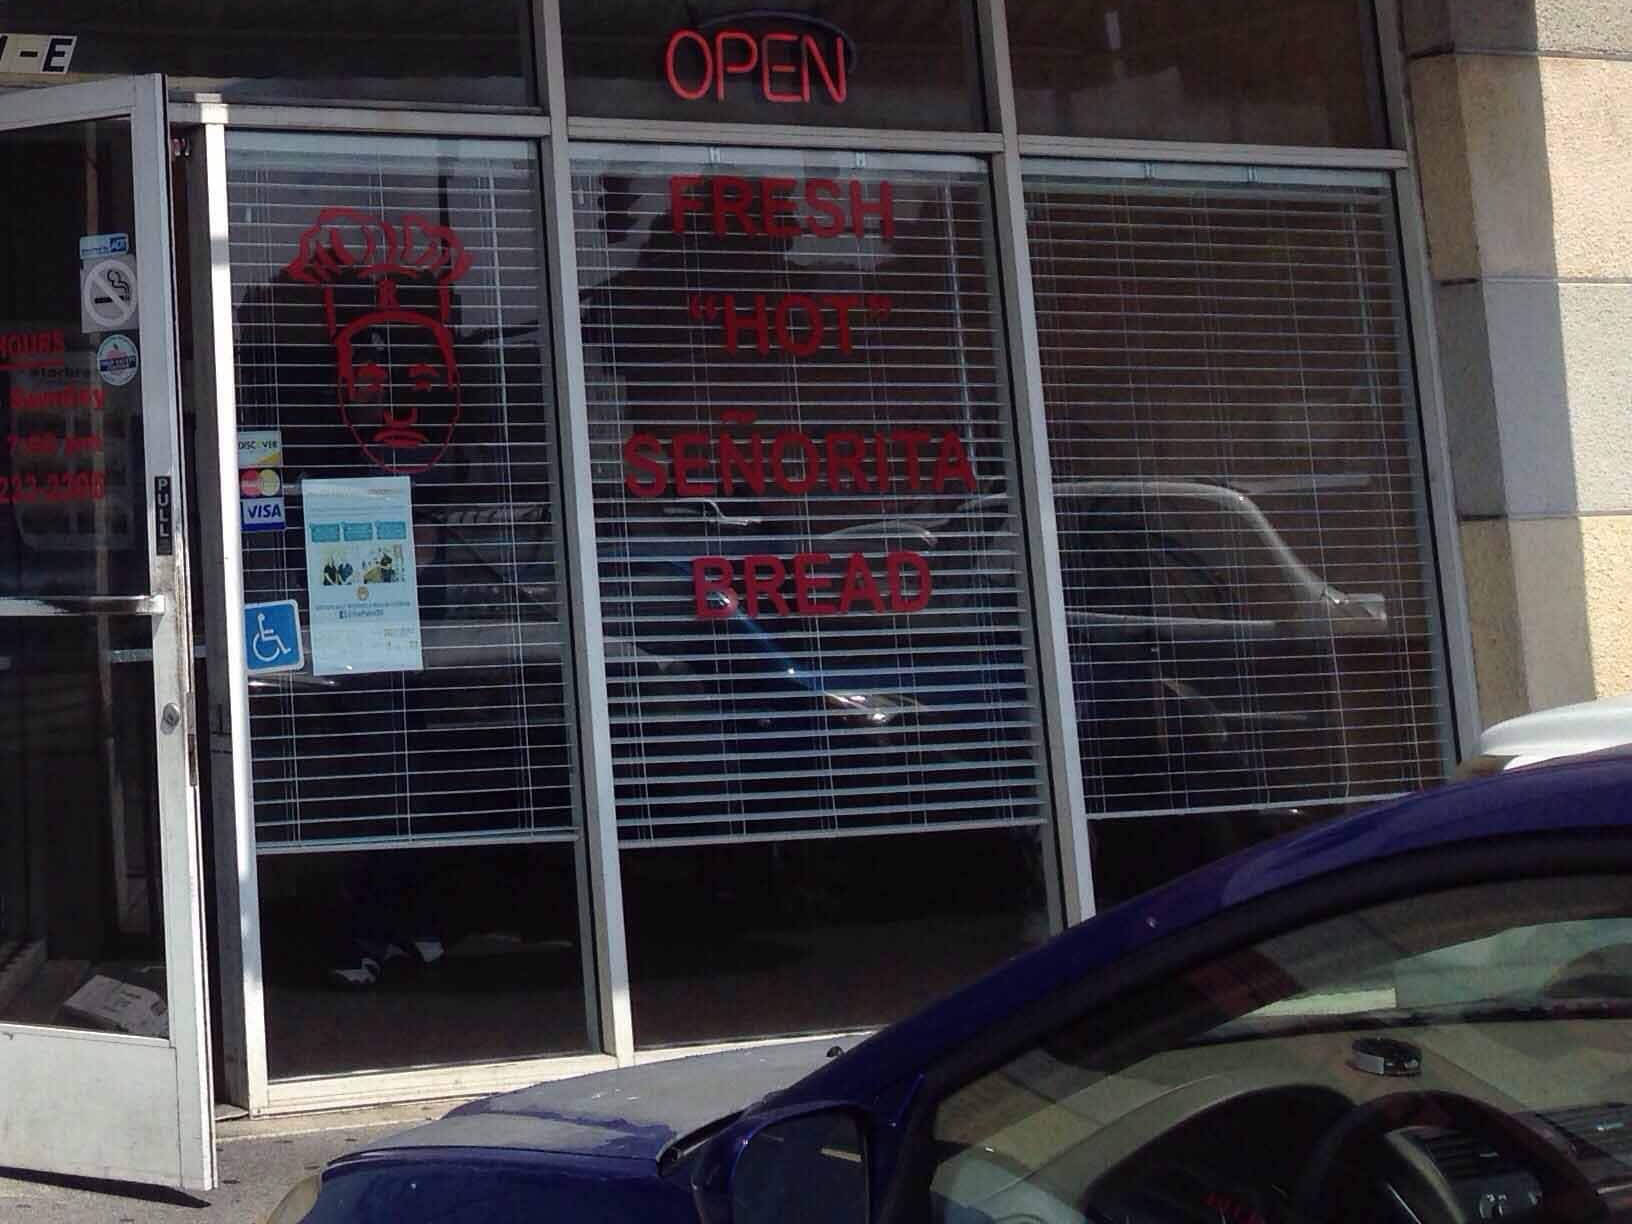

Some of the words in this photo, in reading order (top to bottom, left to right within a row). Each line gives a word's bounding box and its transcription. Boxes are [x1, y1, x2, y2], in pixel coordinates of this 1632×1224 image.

[667, 28, 848, 104] OPEN
[667, 174, 895, 240] FRESH
[622, 410, 976, 498] SEÑORITA
[157, 478, 170, 537] PULL
[247, 503, 282, 519] VISA
[691, 551, 932, 620] BREAD
